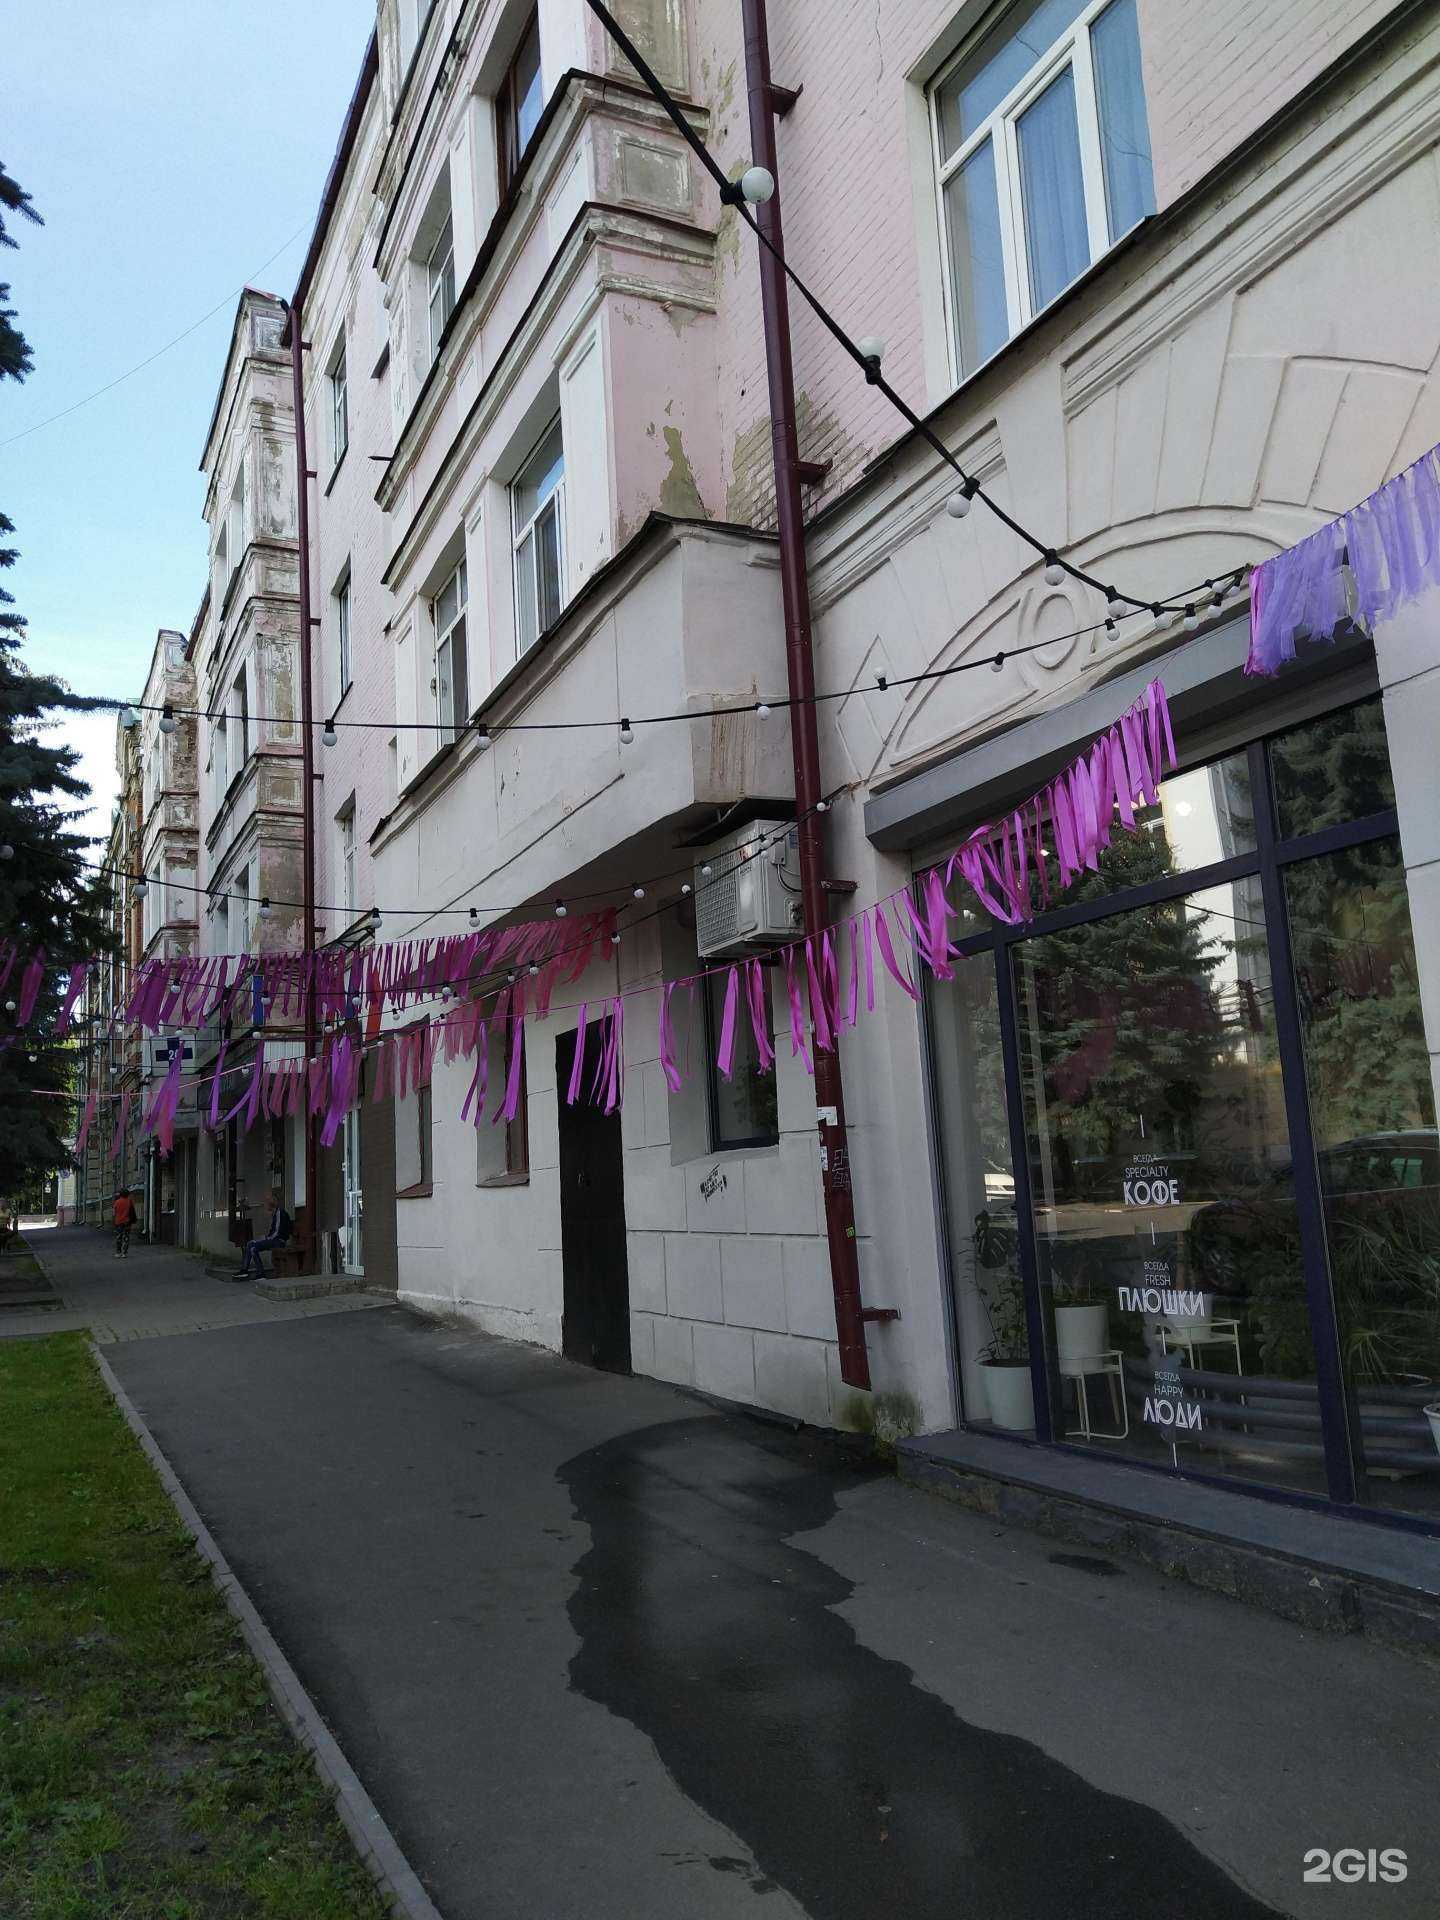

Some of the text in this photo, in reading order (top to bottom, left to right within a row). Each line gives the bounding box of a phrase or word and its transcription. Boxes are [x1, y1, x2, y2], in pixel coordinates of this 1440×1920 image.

[1125, 1165, 1169, 1178] SPECIALTY
[1123, 1179, 1180, 1205] КОФЕ
[1144, 1261, 1170, 1271] ВСЕГДА
[1145, 1274, 1171, 1286] FRESH
[1119, 1286, 1205, 1317] ПЛЮШКИ
[1154, 1370, 1180, 1382] ВСЕГДА
[1154, 1383, 1184, 1398] HAPPY
[1143, 1396, 1203, 1431] ЛЮДИ
